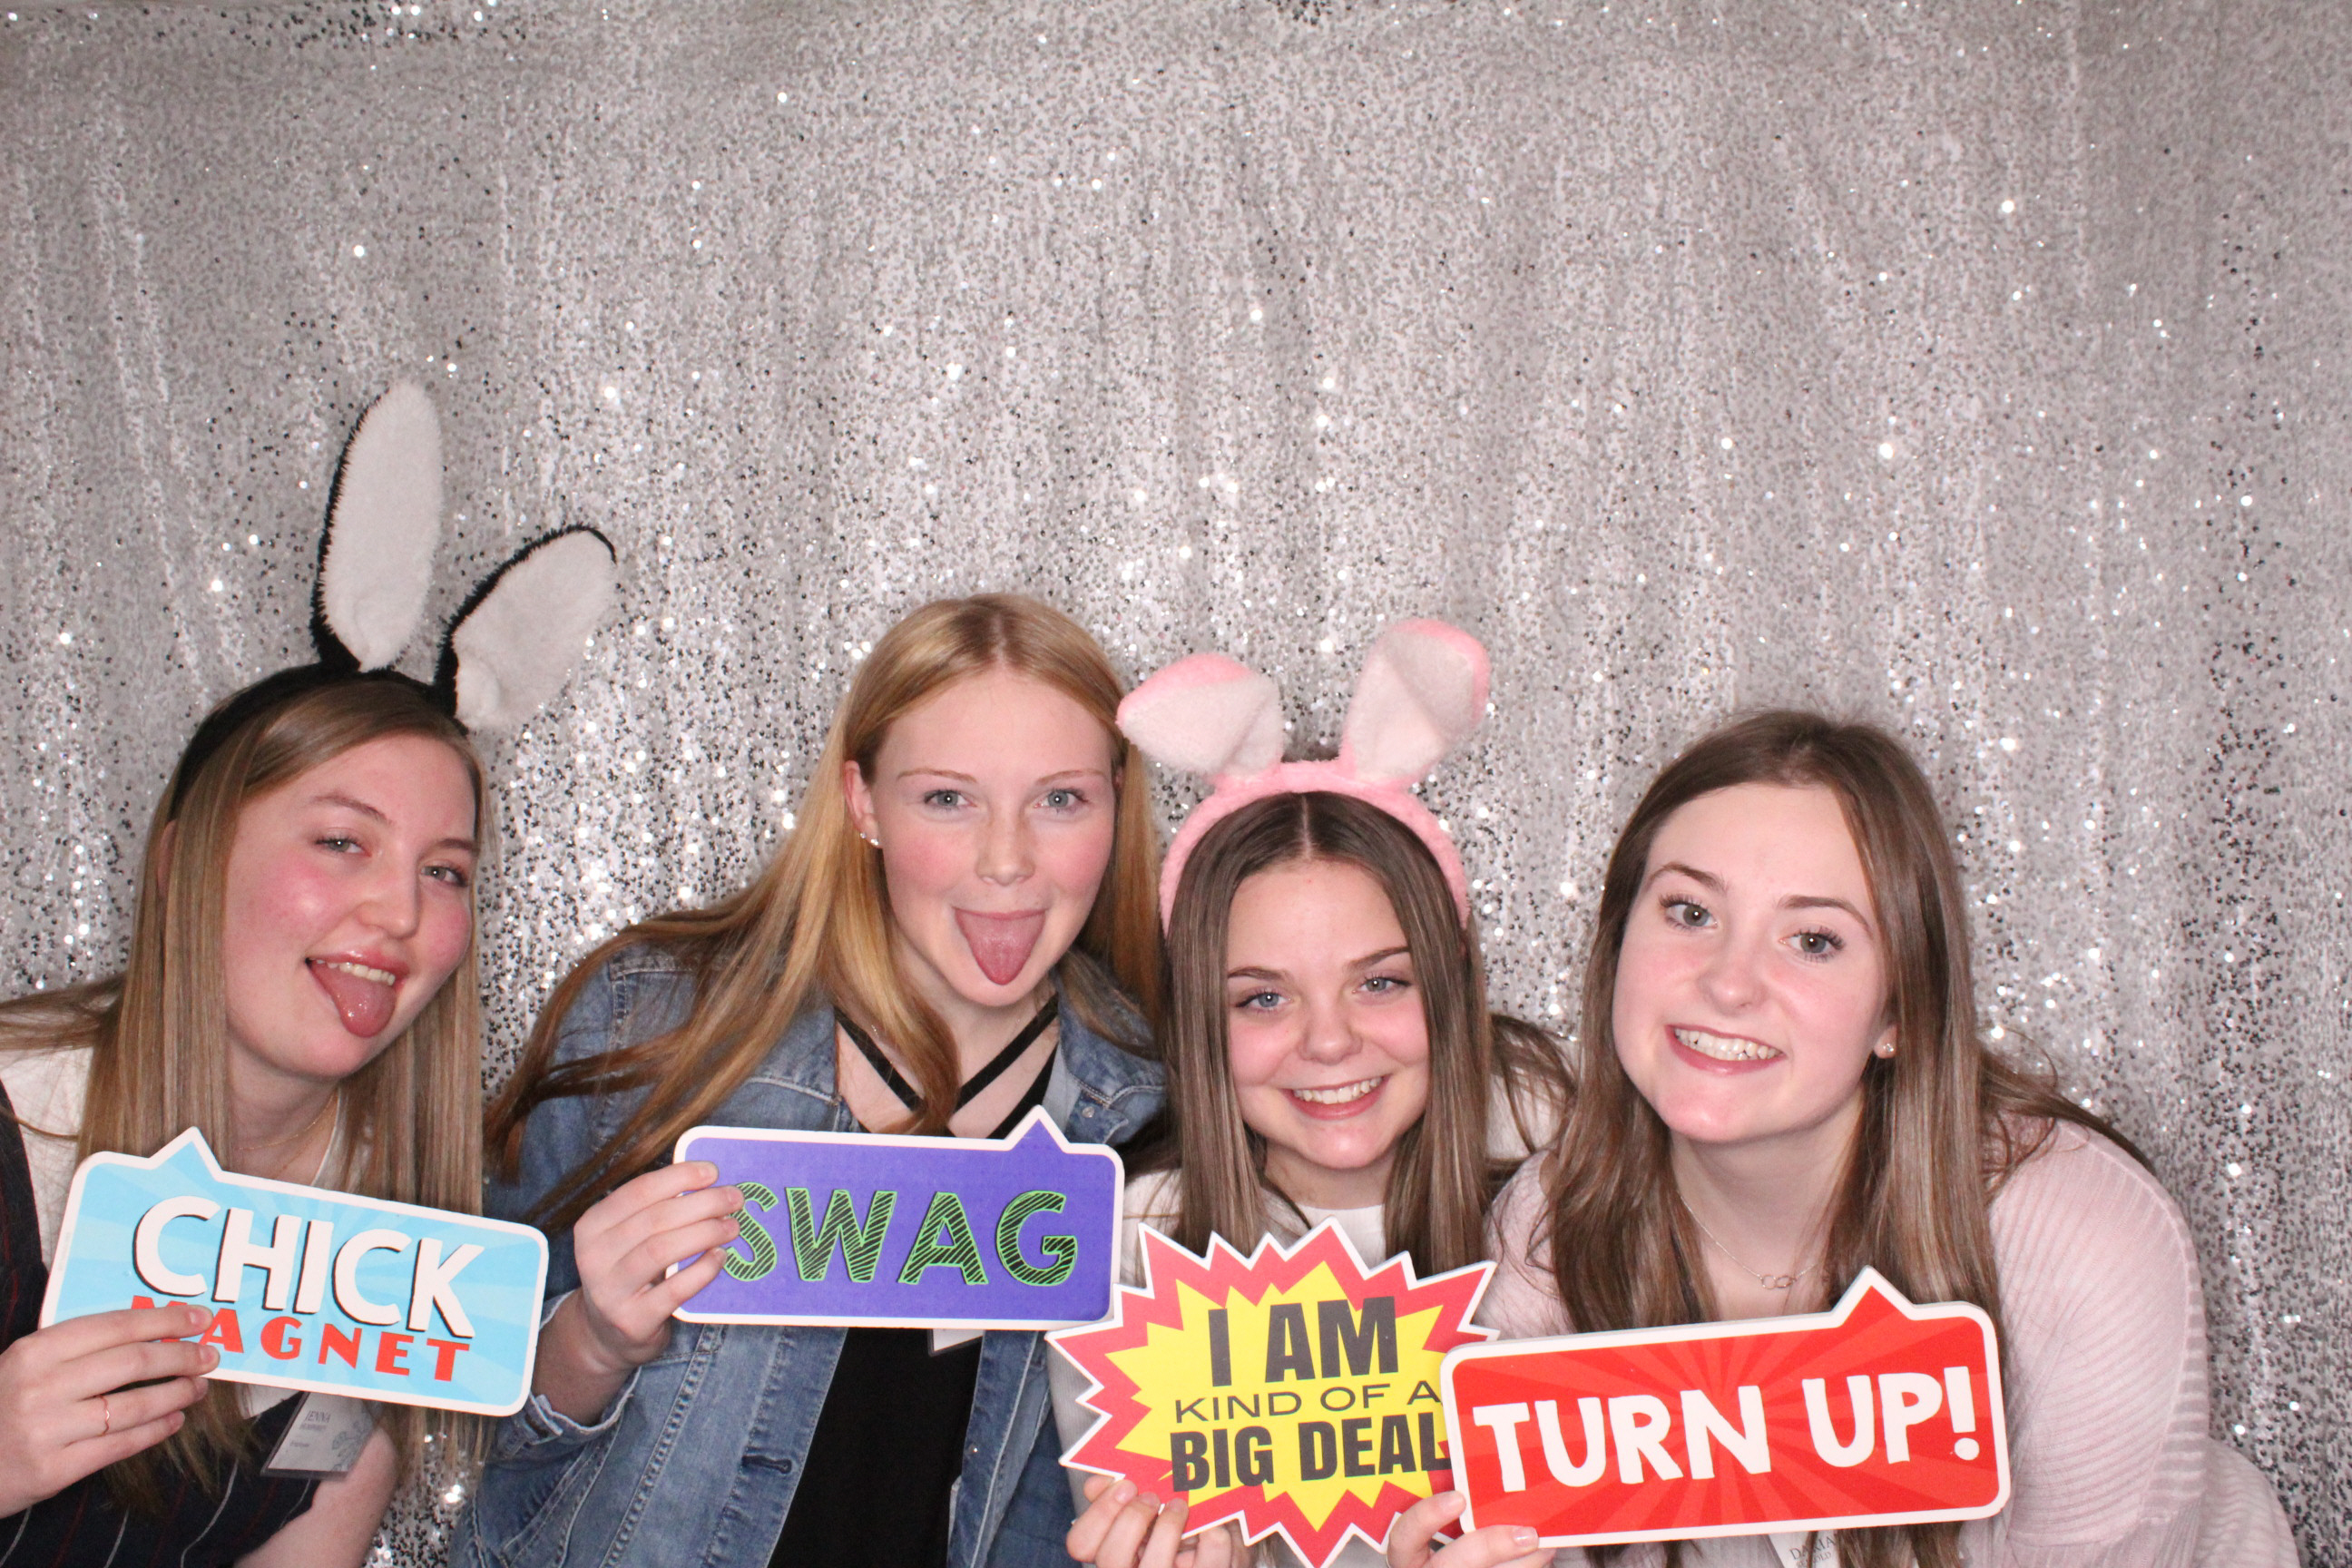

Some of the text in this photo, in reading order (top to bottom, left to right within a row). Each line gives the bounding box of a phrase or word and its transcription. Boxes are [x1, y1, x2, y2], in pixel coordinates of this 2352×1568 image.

[132, 1195, 485, 1338] CHICK
[721, 1181, 1078, 1287] SWAG
[1208, 1295, 1399, 1387] I AM
[1174, 1380, 1441, 1424] KIND OF A
[1473, 1366, 1980, 1493] TURN UP!
[1170, 1411, 1452, 1493] BIG DEAL
